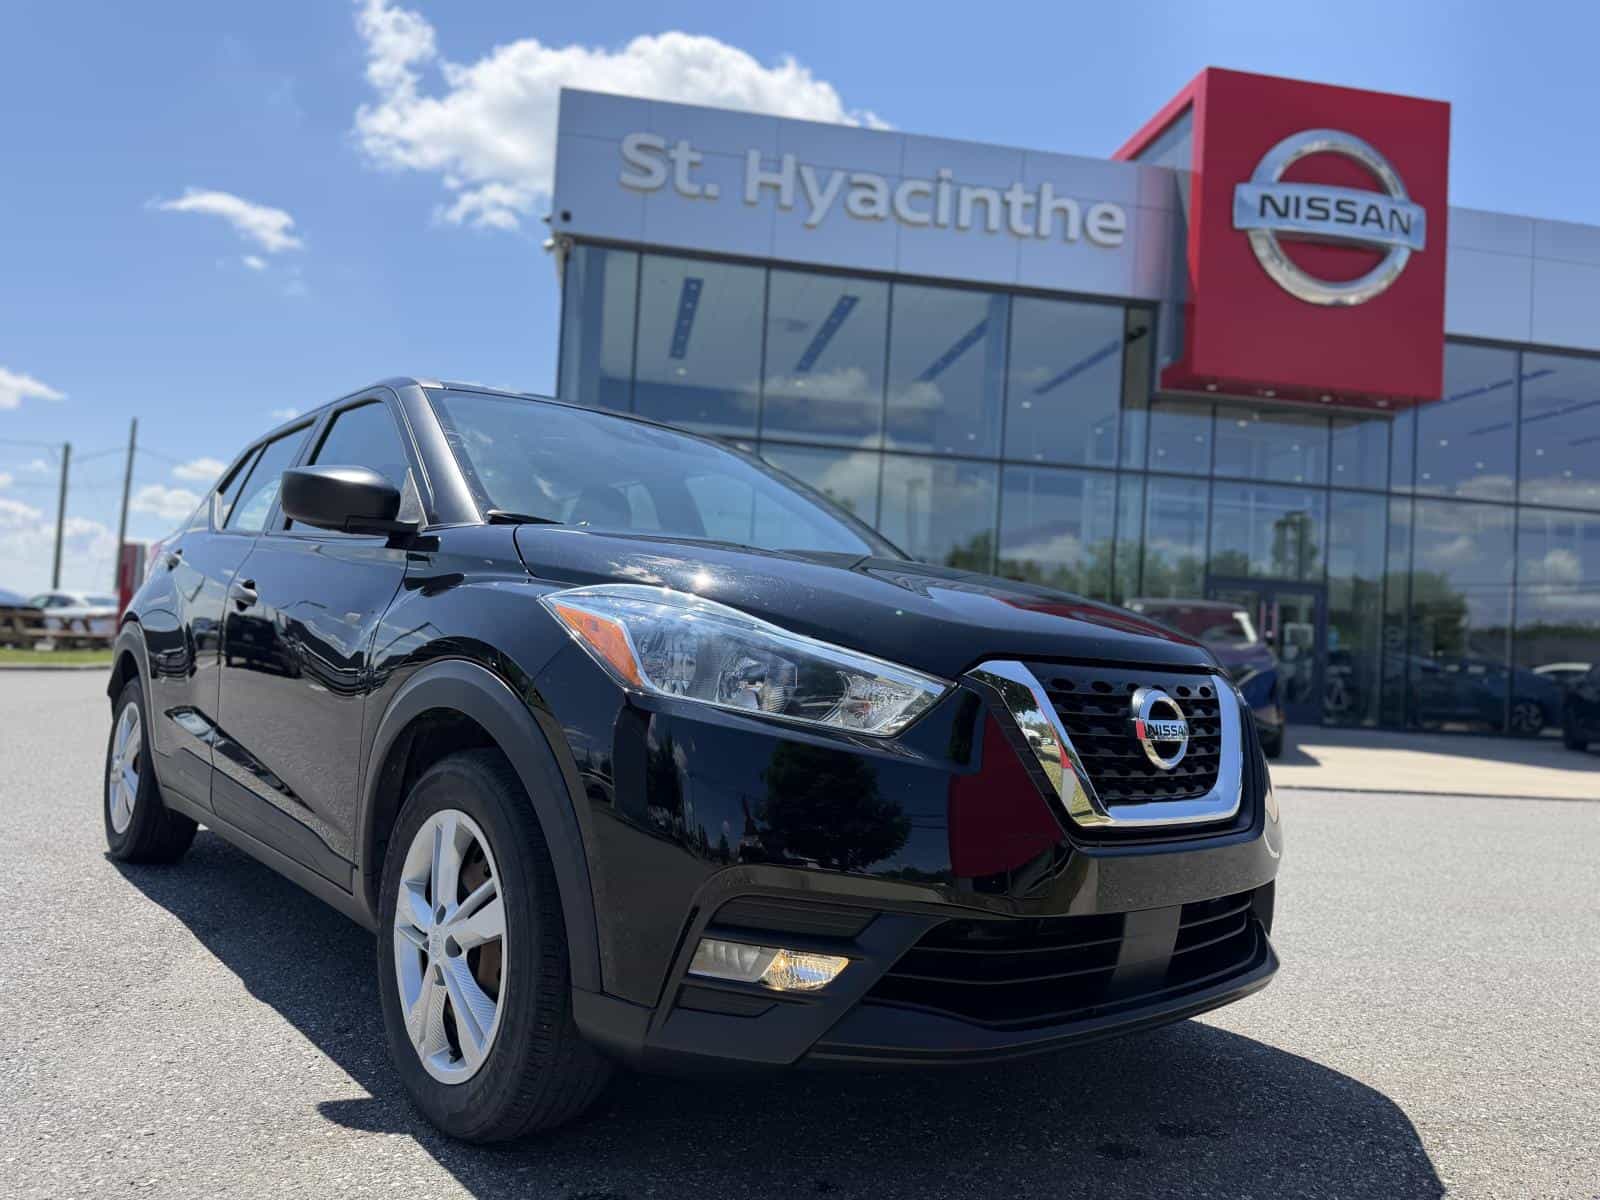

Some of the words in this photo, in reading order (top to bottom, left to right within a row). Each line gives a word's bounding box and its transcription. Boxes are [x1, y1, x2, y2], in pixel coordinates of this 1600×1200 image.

[619, 132, 718, 200] St.
[744, 150, 1127, 246] Hyacinthe
[1258, 194, 1411, 235] NISSAN
